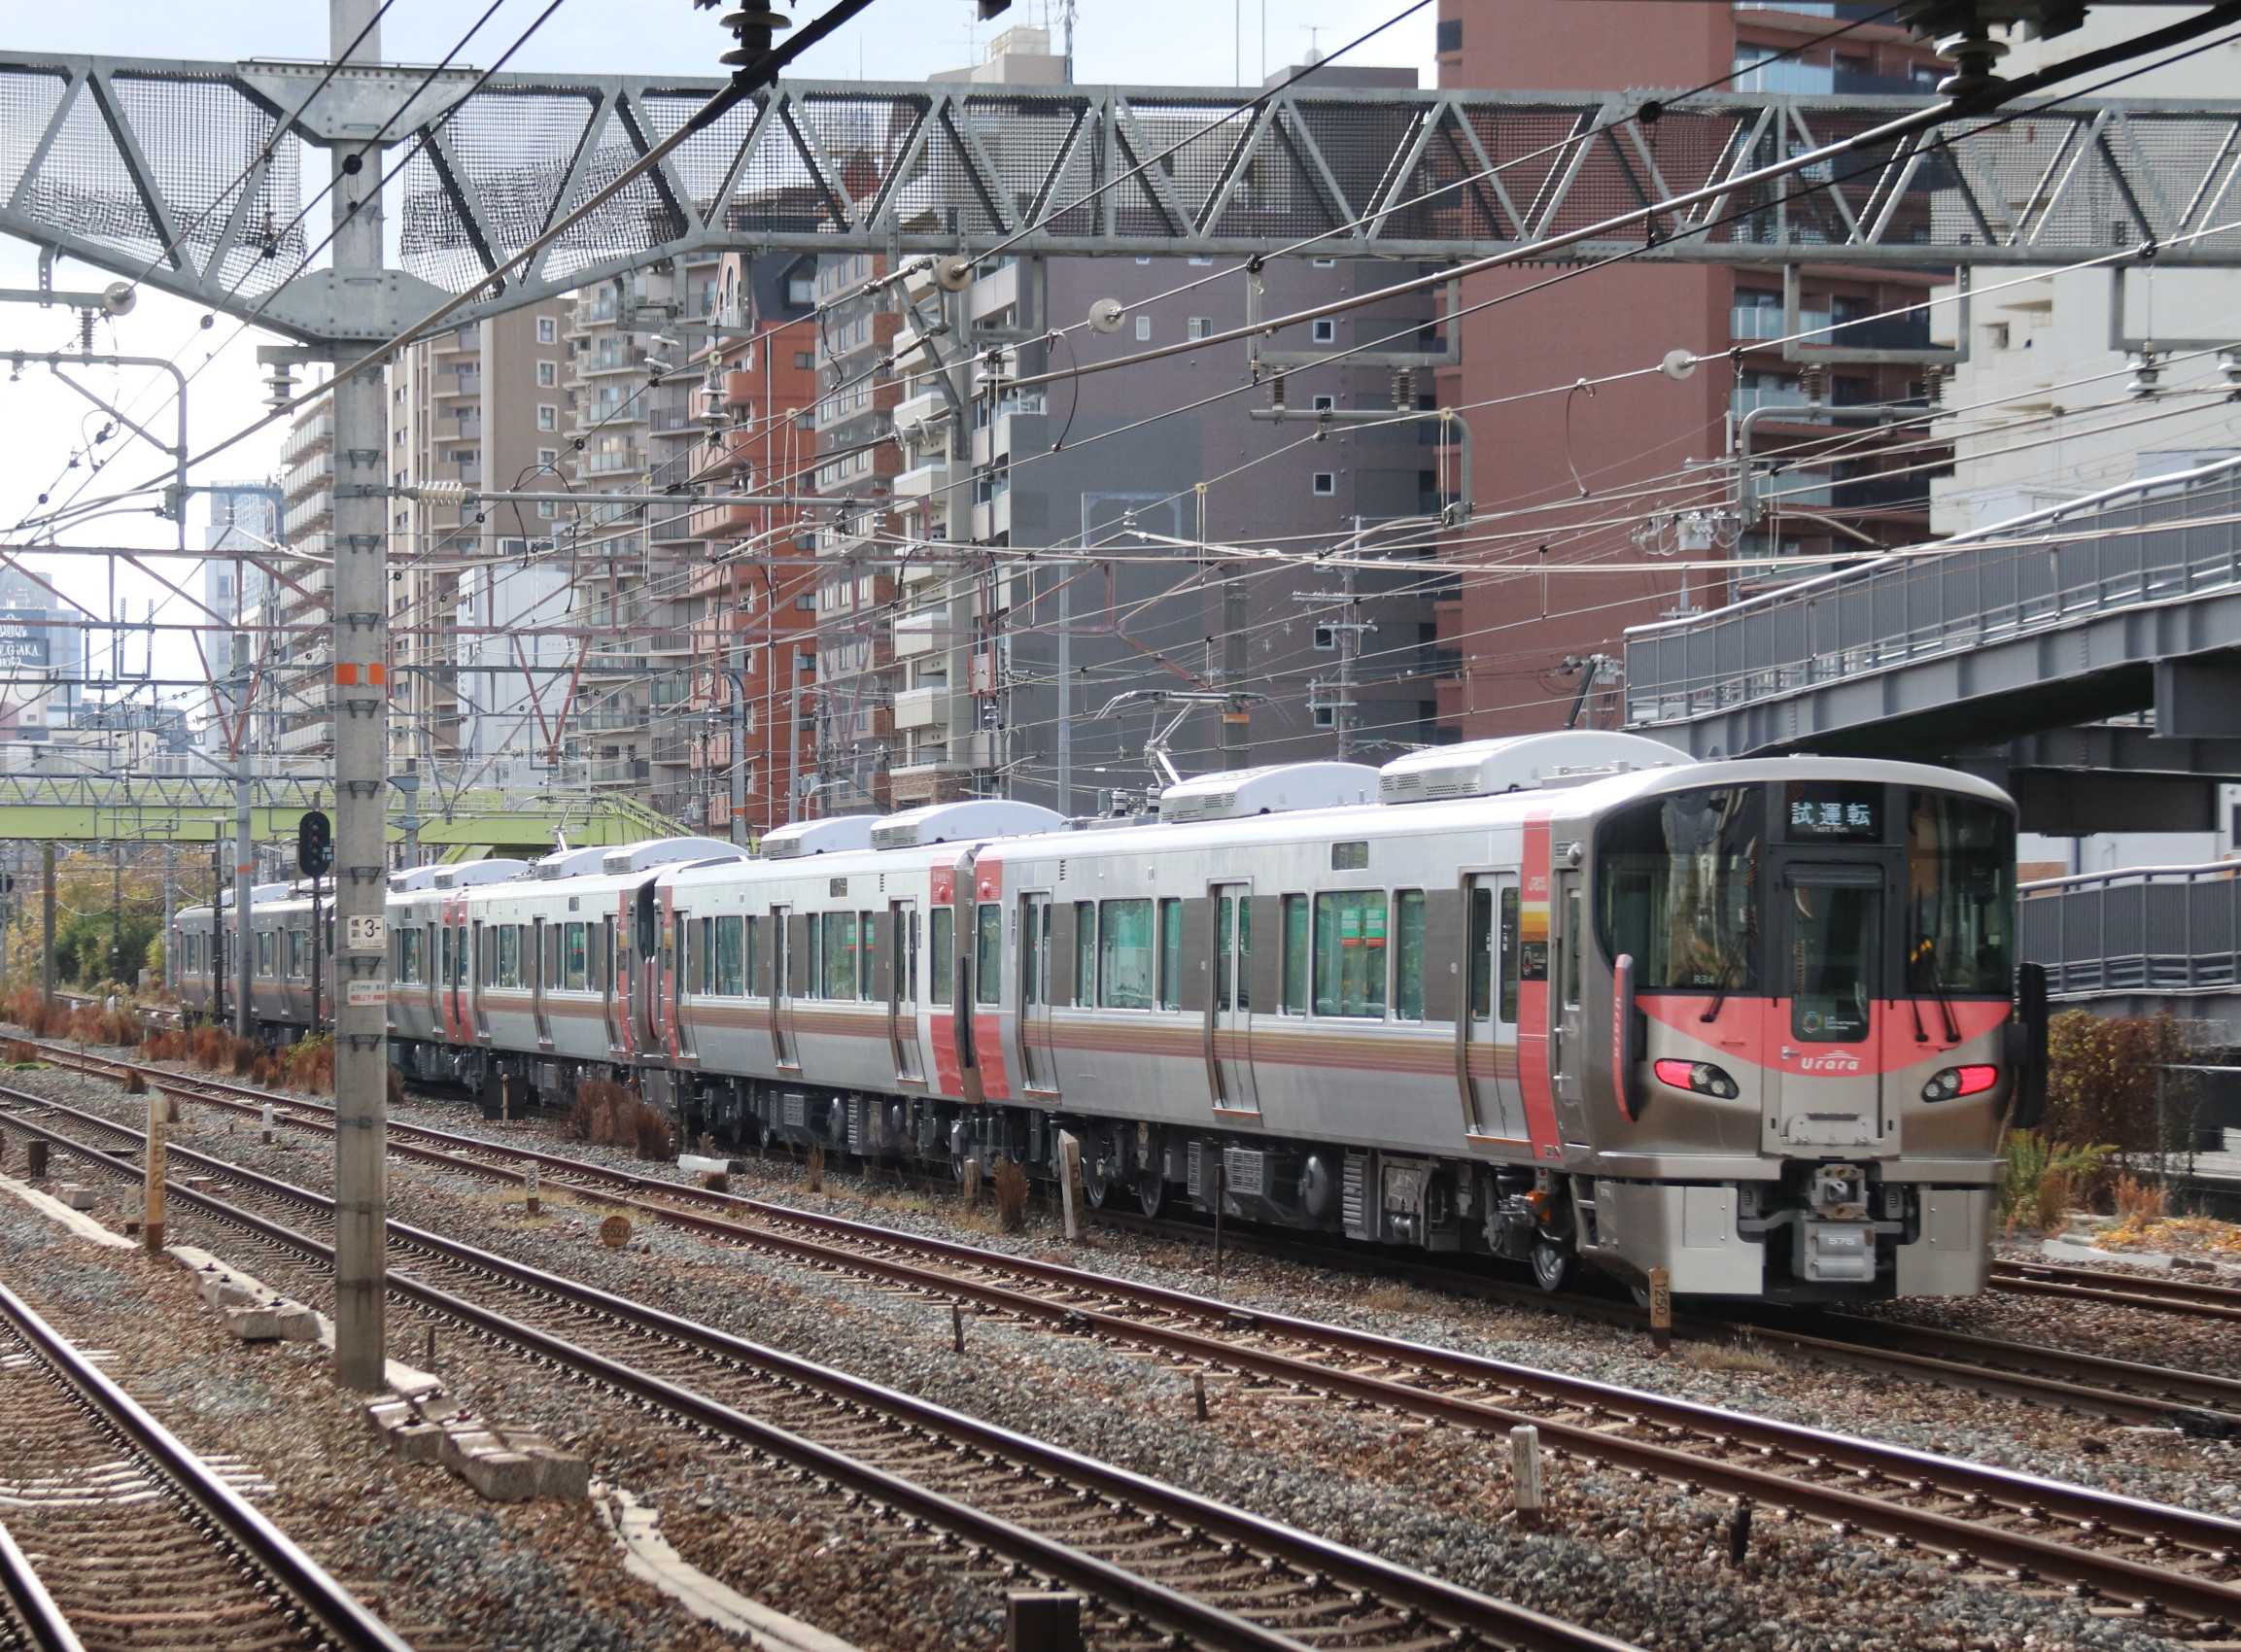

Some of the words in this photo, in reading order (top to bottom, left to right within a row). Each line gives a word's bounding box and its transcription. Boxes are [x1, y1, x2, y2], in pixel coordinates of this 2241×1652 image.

[1791, 802, 1871, 826] 試運転
[1694, 975, 1714, 984] R34
[1801, 1057, 1859, 1070] Urara
[1654, 1283, 1669, 1315] 1250
